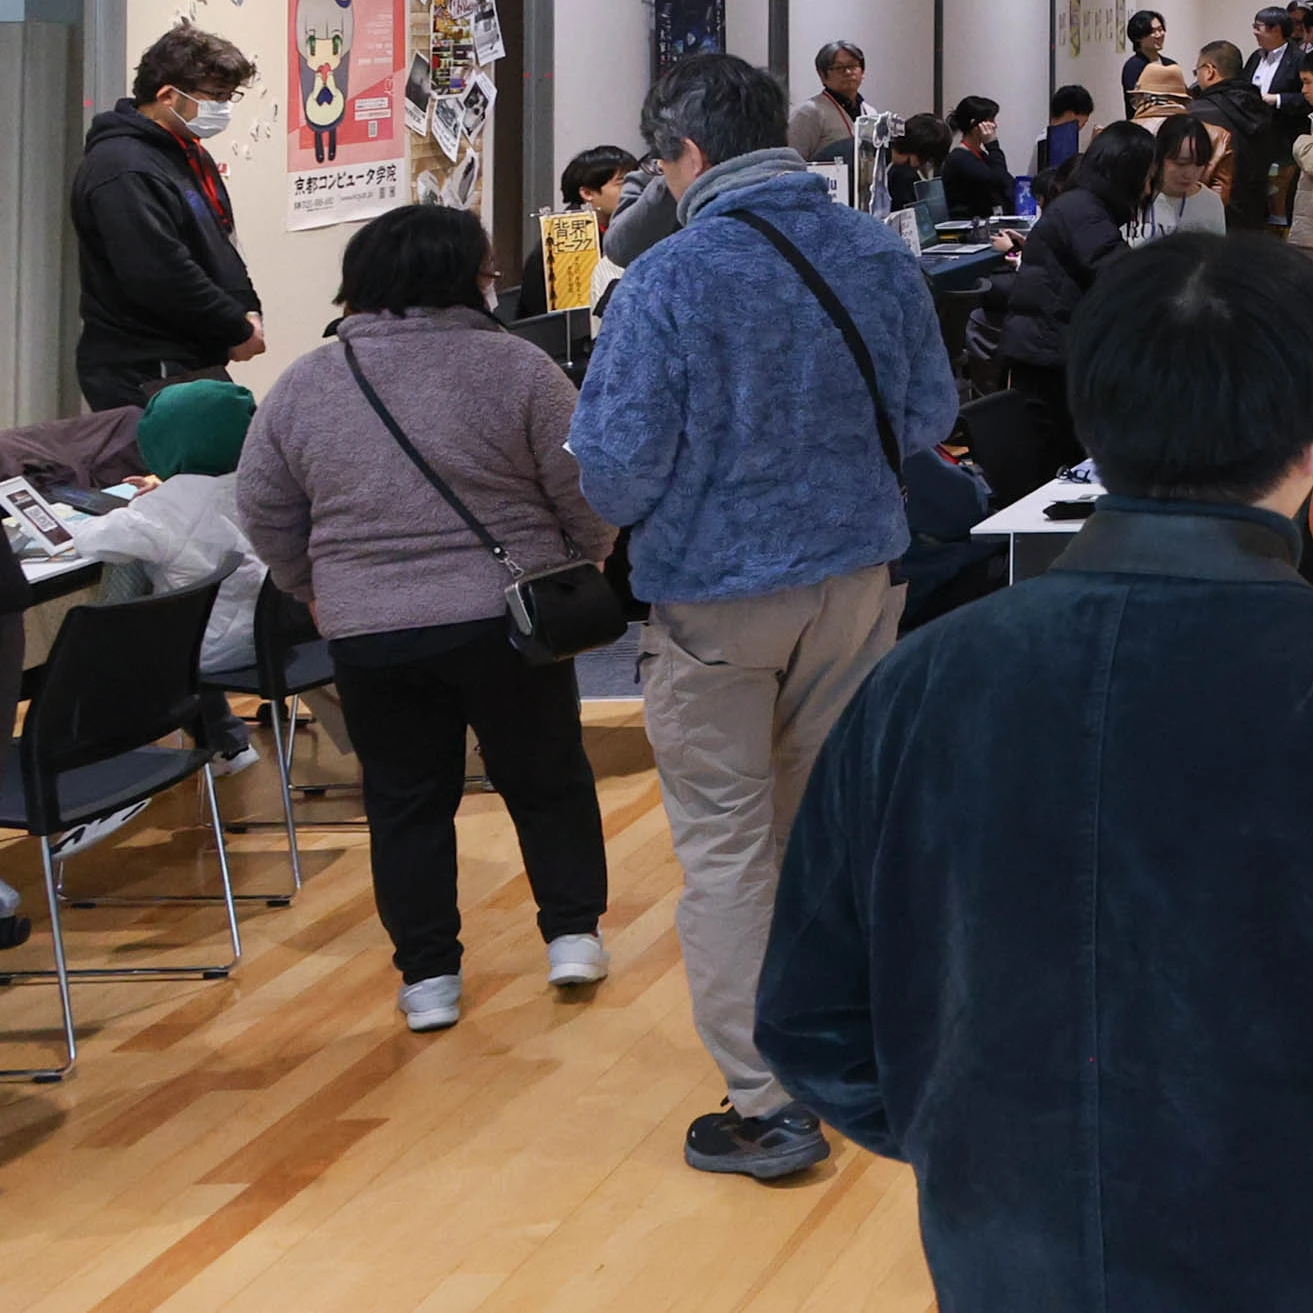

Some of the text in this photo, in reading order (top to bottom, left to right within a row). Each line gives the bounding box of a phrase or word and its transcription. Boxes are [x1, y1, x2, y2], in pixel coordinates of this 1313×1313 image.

[294, 164, 397, 196] 京都コンピュータ学院
